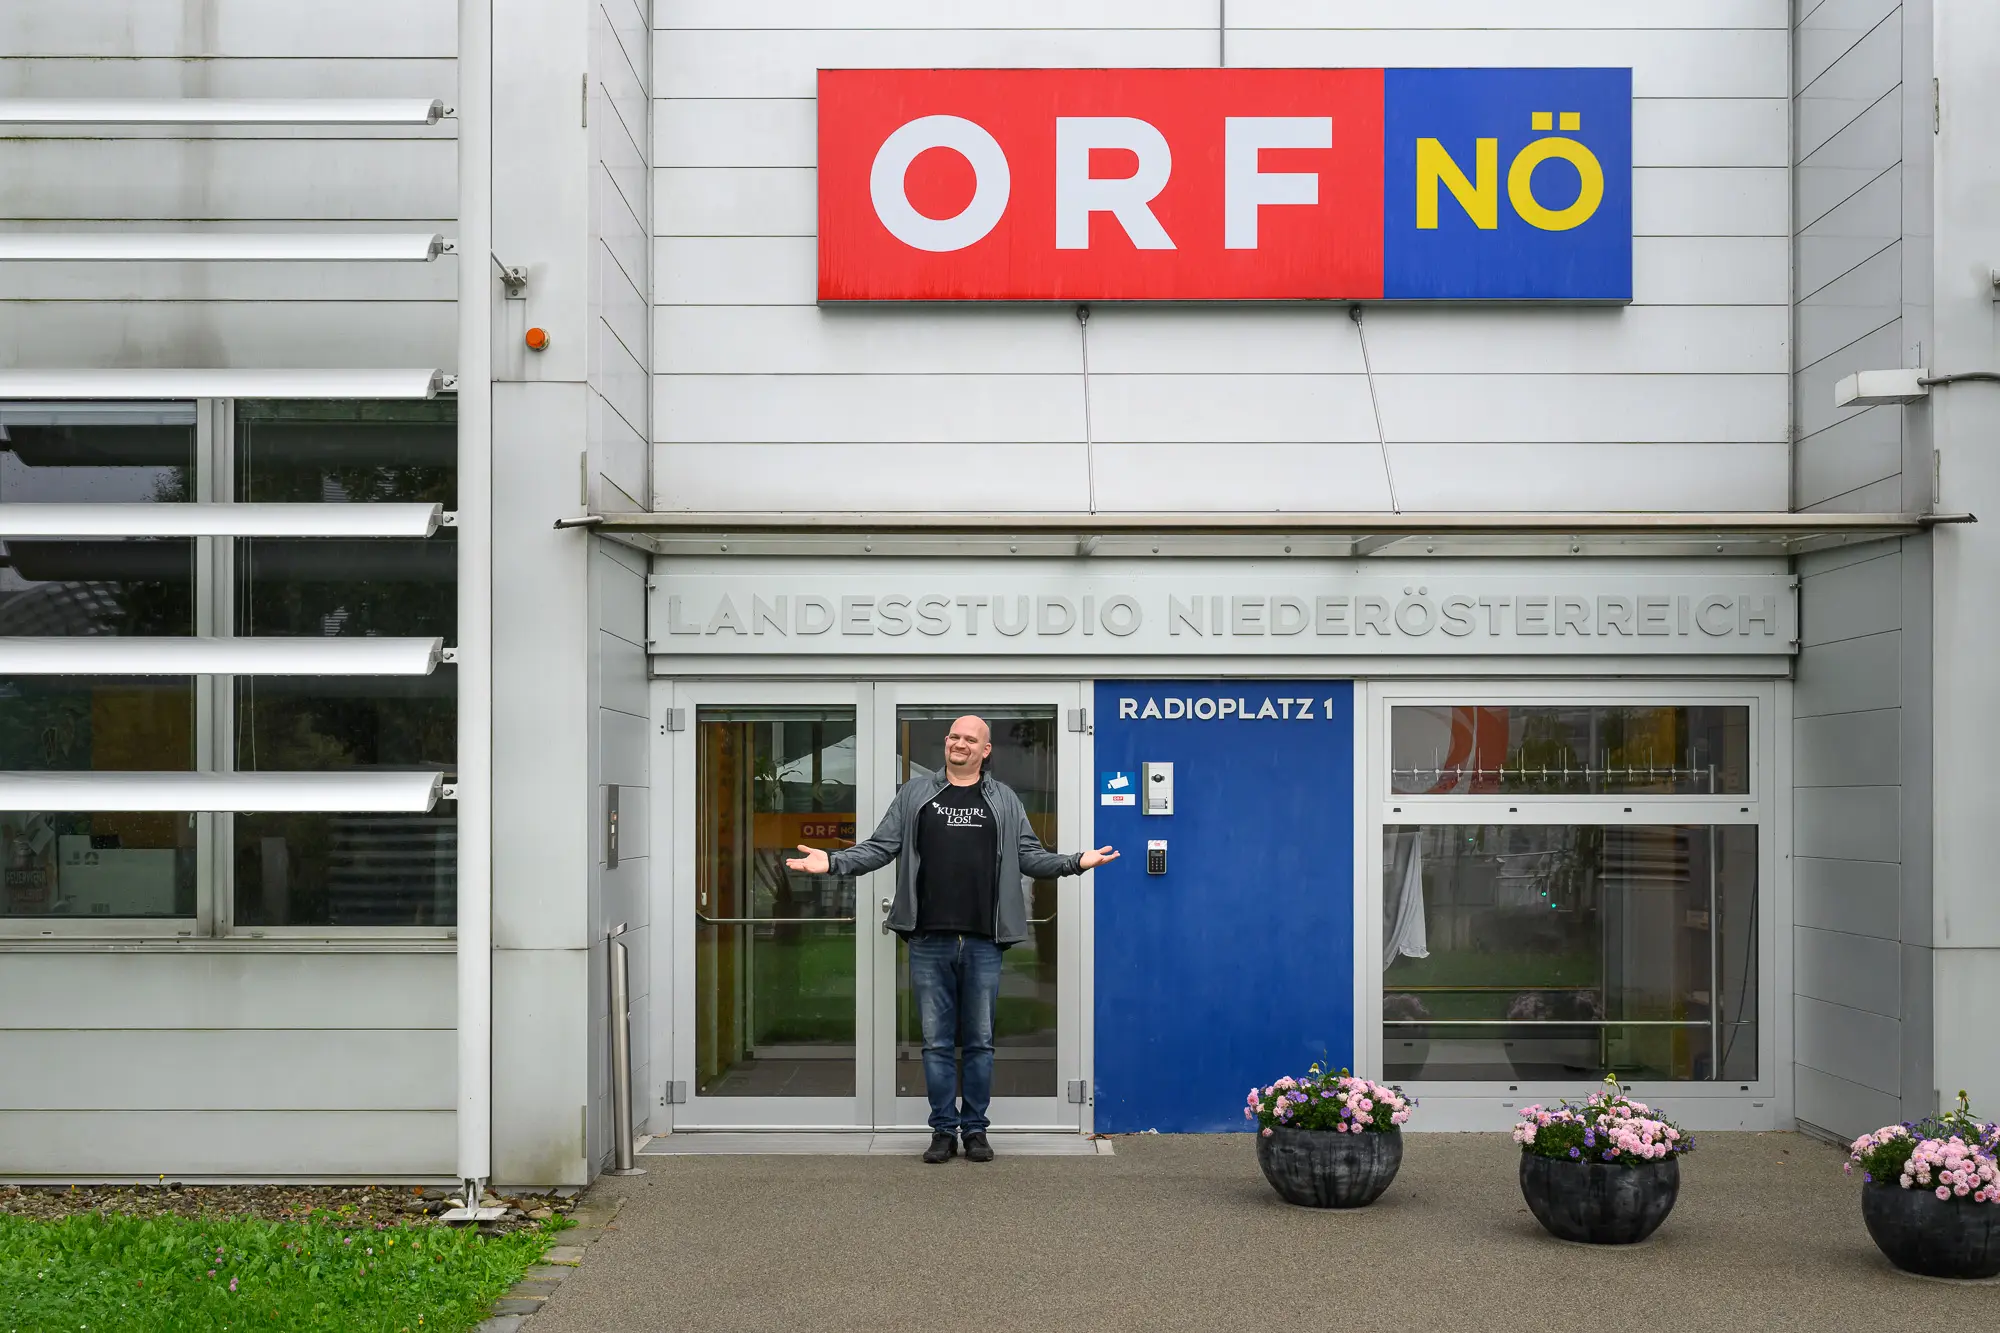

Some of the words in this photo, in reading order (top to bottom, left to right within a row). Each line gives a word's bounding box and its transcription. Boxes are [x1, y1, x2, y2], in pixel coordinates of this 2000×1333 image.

[869, 114, 1333, 252] ORF
[1416, 111, 1604, 231] NÖ
[668, 592, 1142, 636] LANDESSTUDIO
[1168, 586, 1775, 636] NIEDERÖSTERREICH
[1119, 697, 1314, 720] RADIOPLATZ
[1323, 697, 1333, 720] 1
[937, 806, 986, 818] KULTUR!
[947, 816, 971, 824] LOS!
[803, 825, 837, 836] ORF
[840, 825, 855, 835] NÖ
